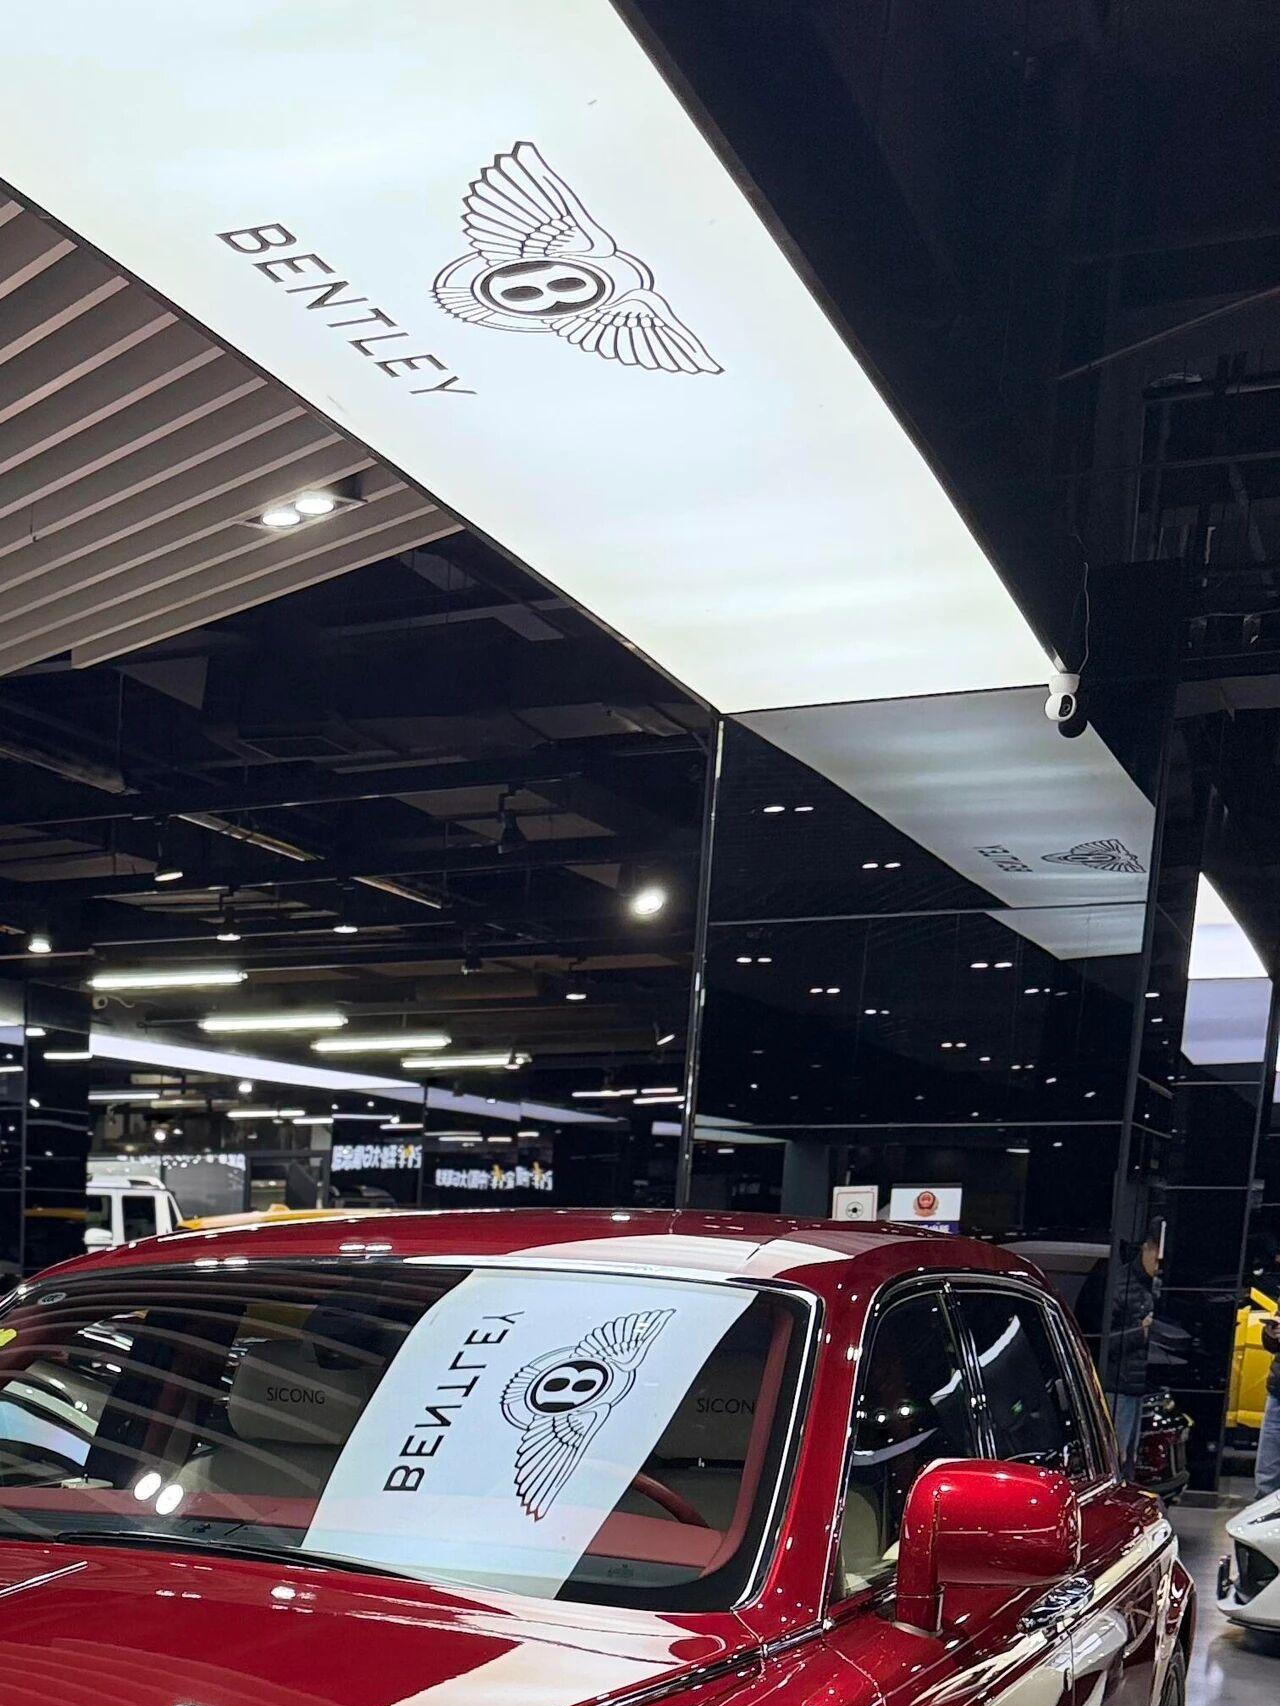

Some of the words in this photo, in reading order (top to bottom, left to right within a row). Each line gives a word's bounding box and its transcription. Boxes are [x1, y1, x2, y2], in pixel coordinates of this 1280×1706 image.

[216, 222, 477, 396] BENTLEY
[266, 1386, 326, 1405] SICONG
[695, 1397, 755, 1416] SICON
